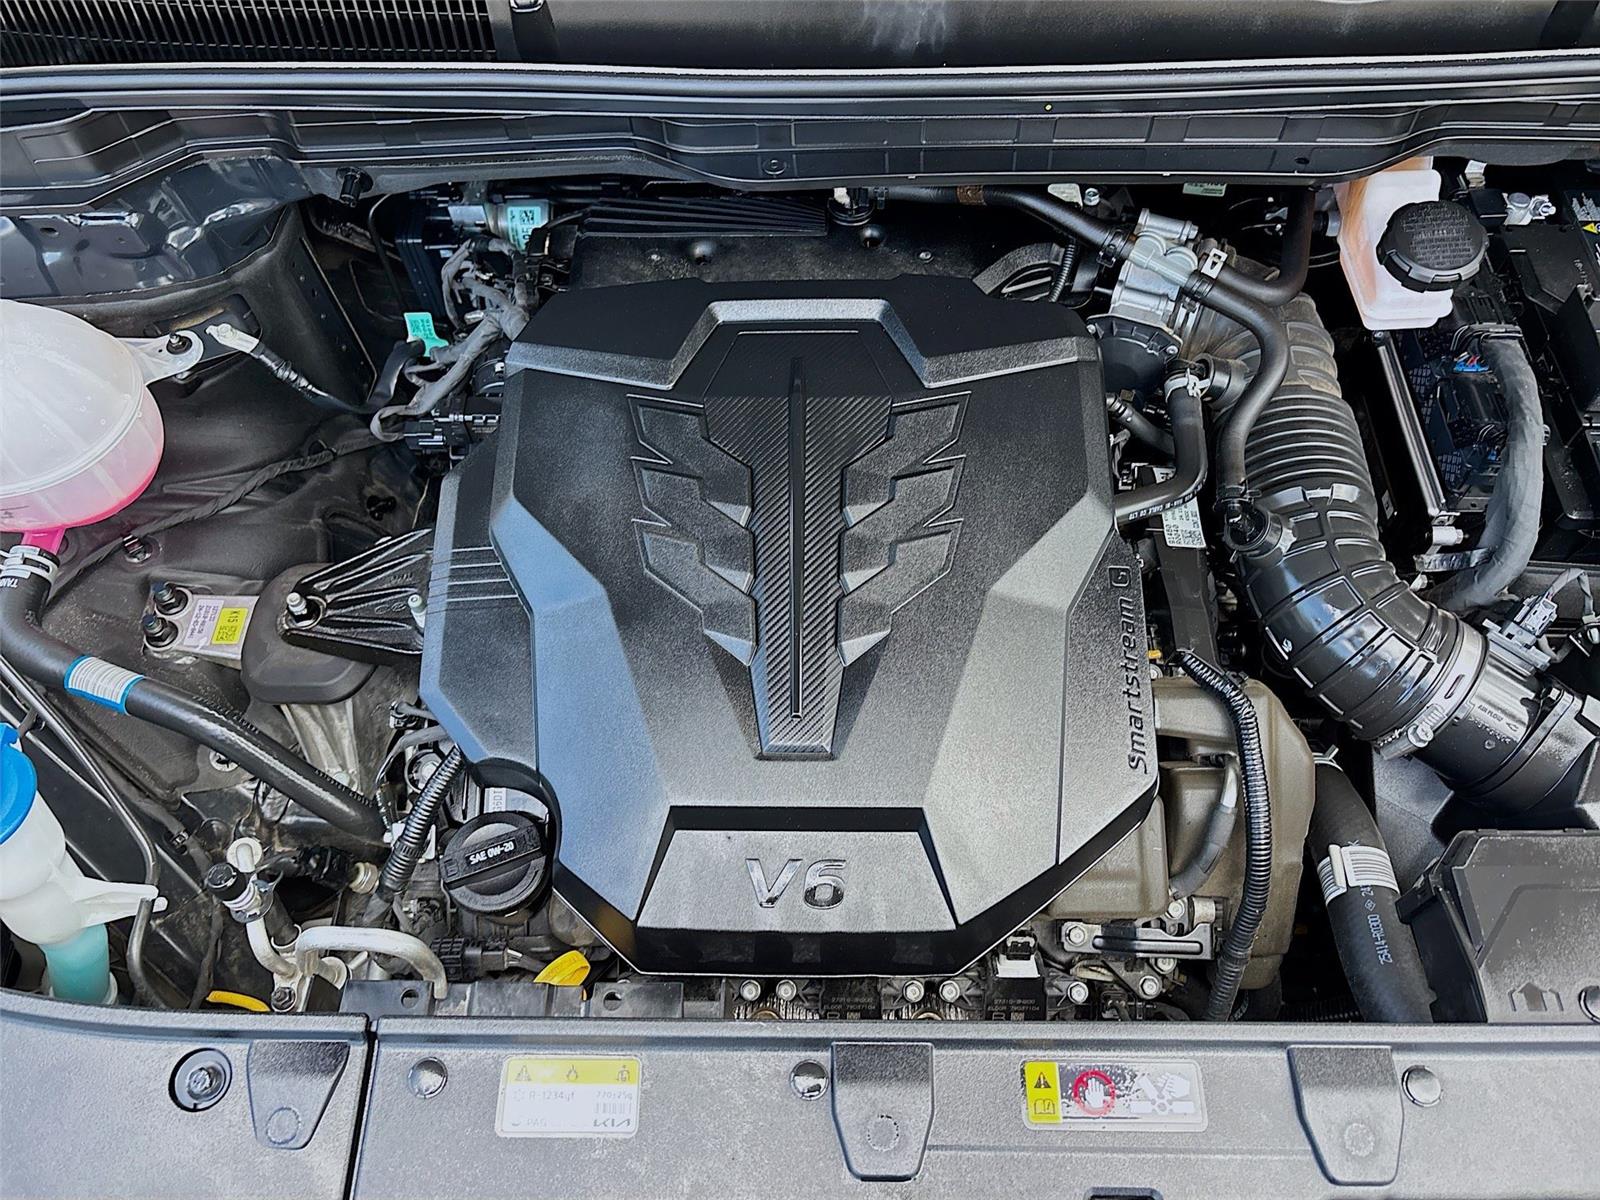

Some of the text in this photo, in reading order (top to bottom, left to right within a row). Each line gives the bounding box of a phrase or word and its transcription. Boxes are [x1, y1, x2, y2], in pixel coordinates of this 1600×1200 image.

[1118, 597, 1148, 775] Smartstream
[469, 841, 515, 865] SAE 0W-20
[744, 857, 846, 911] V6
[593, 1117, 631, 1128] KIA
